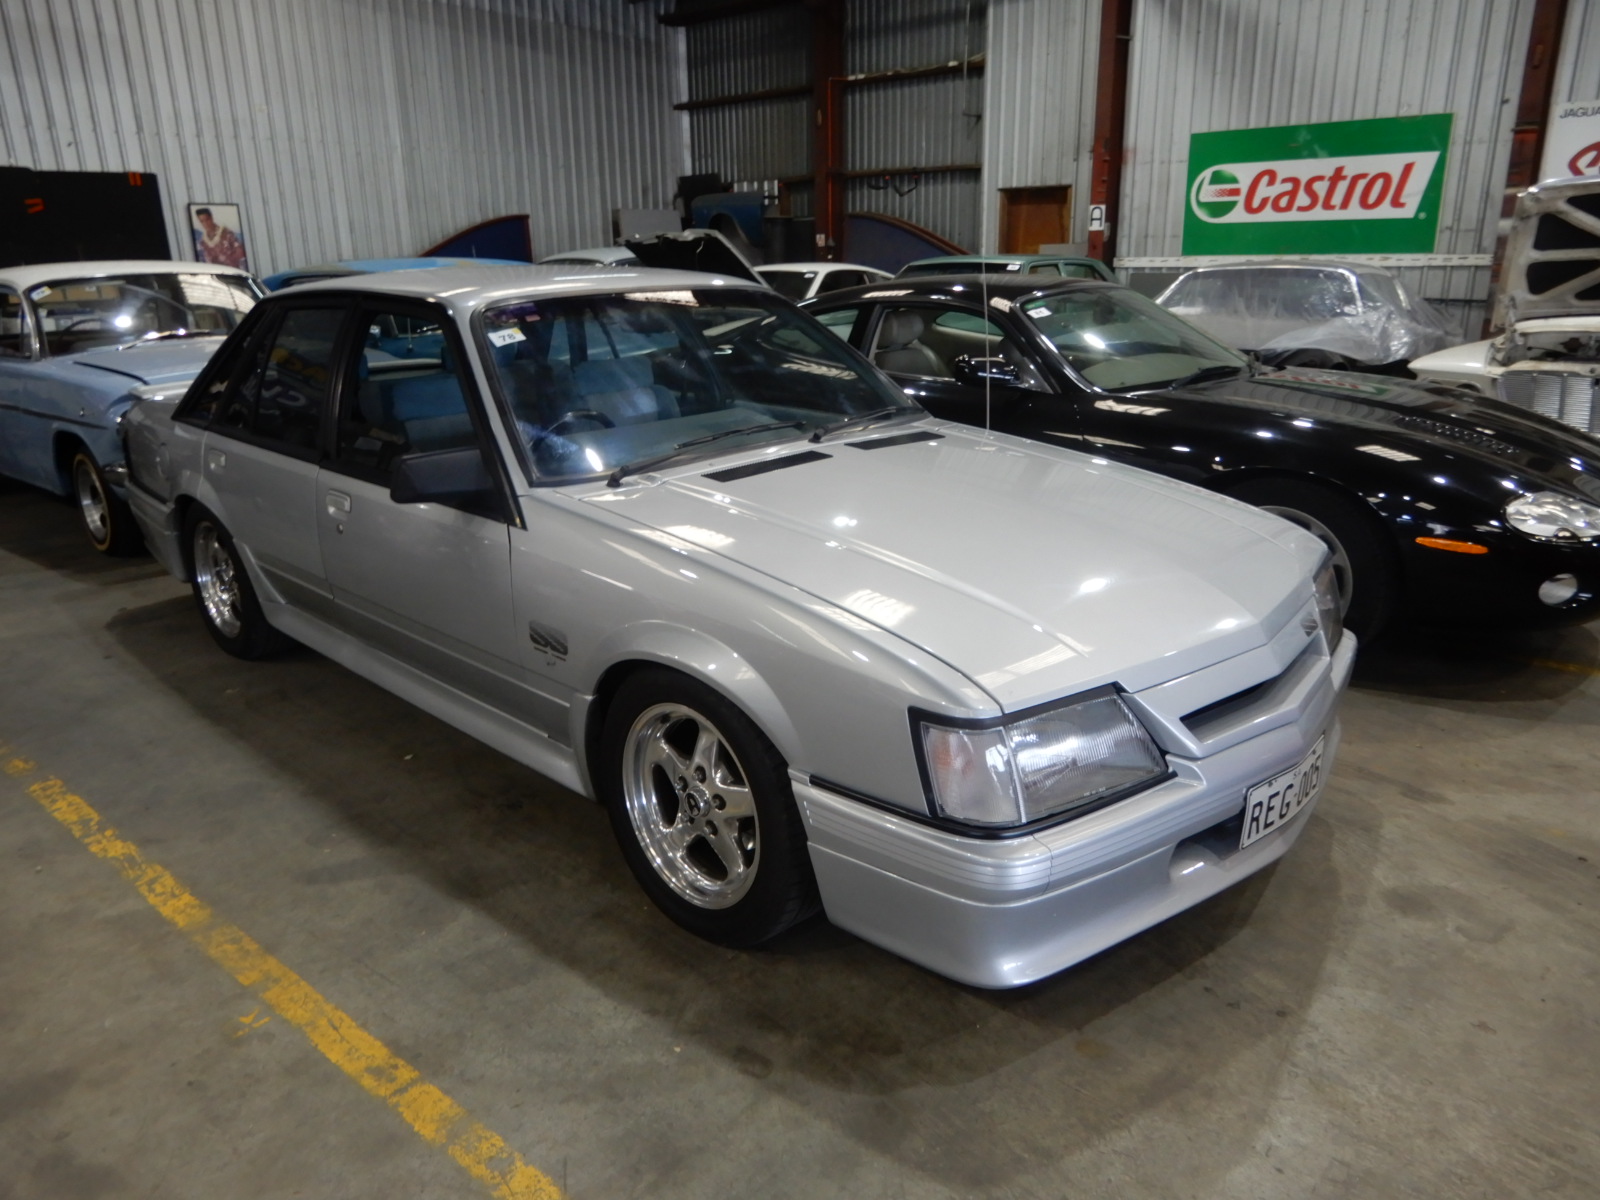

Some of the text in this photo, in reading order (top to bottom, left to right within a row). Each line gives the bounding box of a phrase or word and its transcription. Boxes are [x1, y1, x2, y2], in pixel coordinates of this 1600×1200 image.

[1243, 161, 1416, 215] Castrol
[1090, 206, 1103, 228] A
[498, 332, 516, 342] 78
